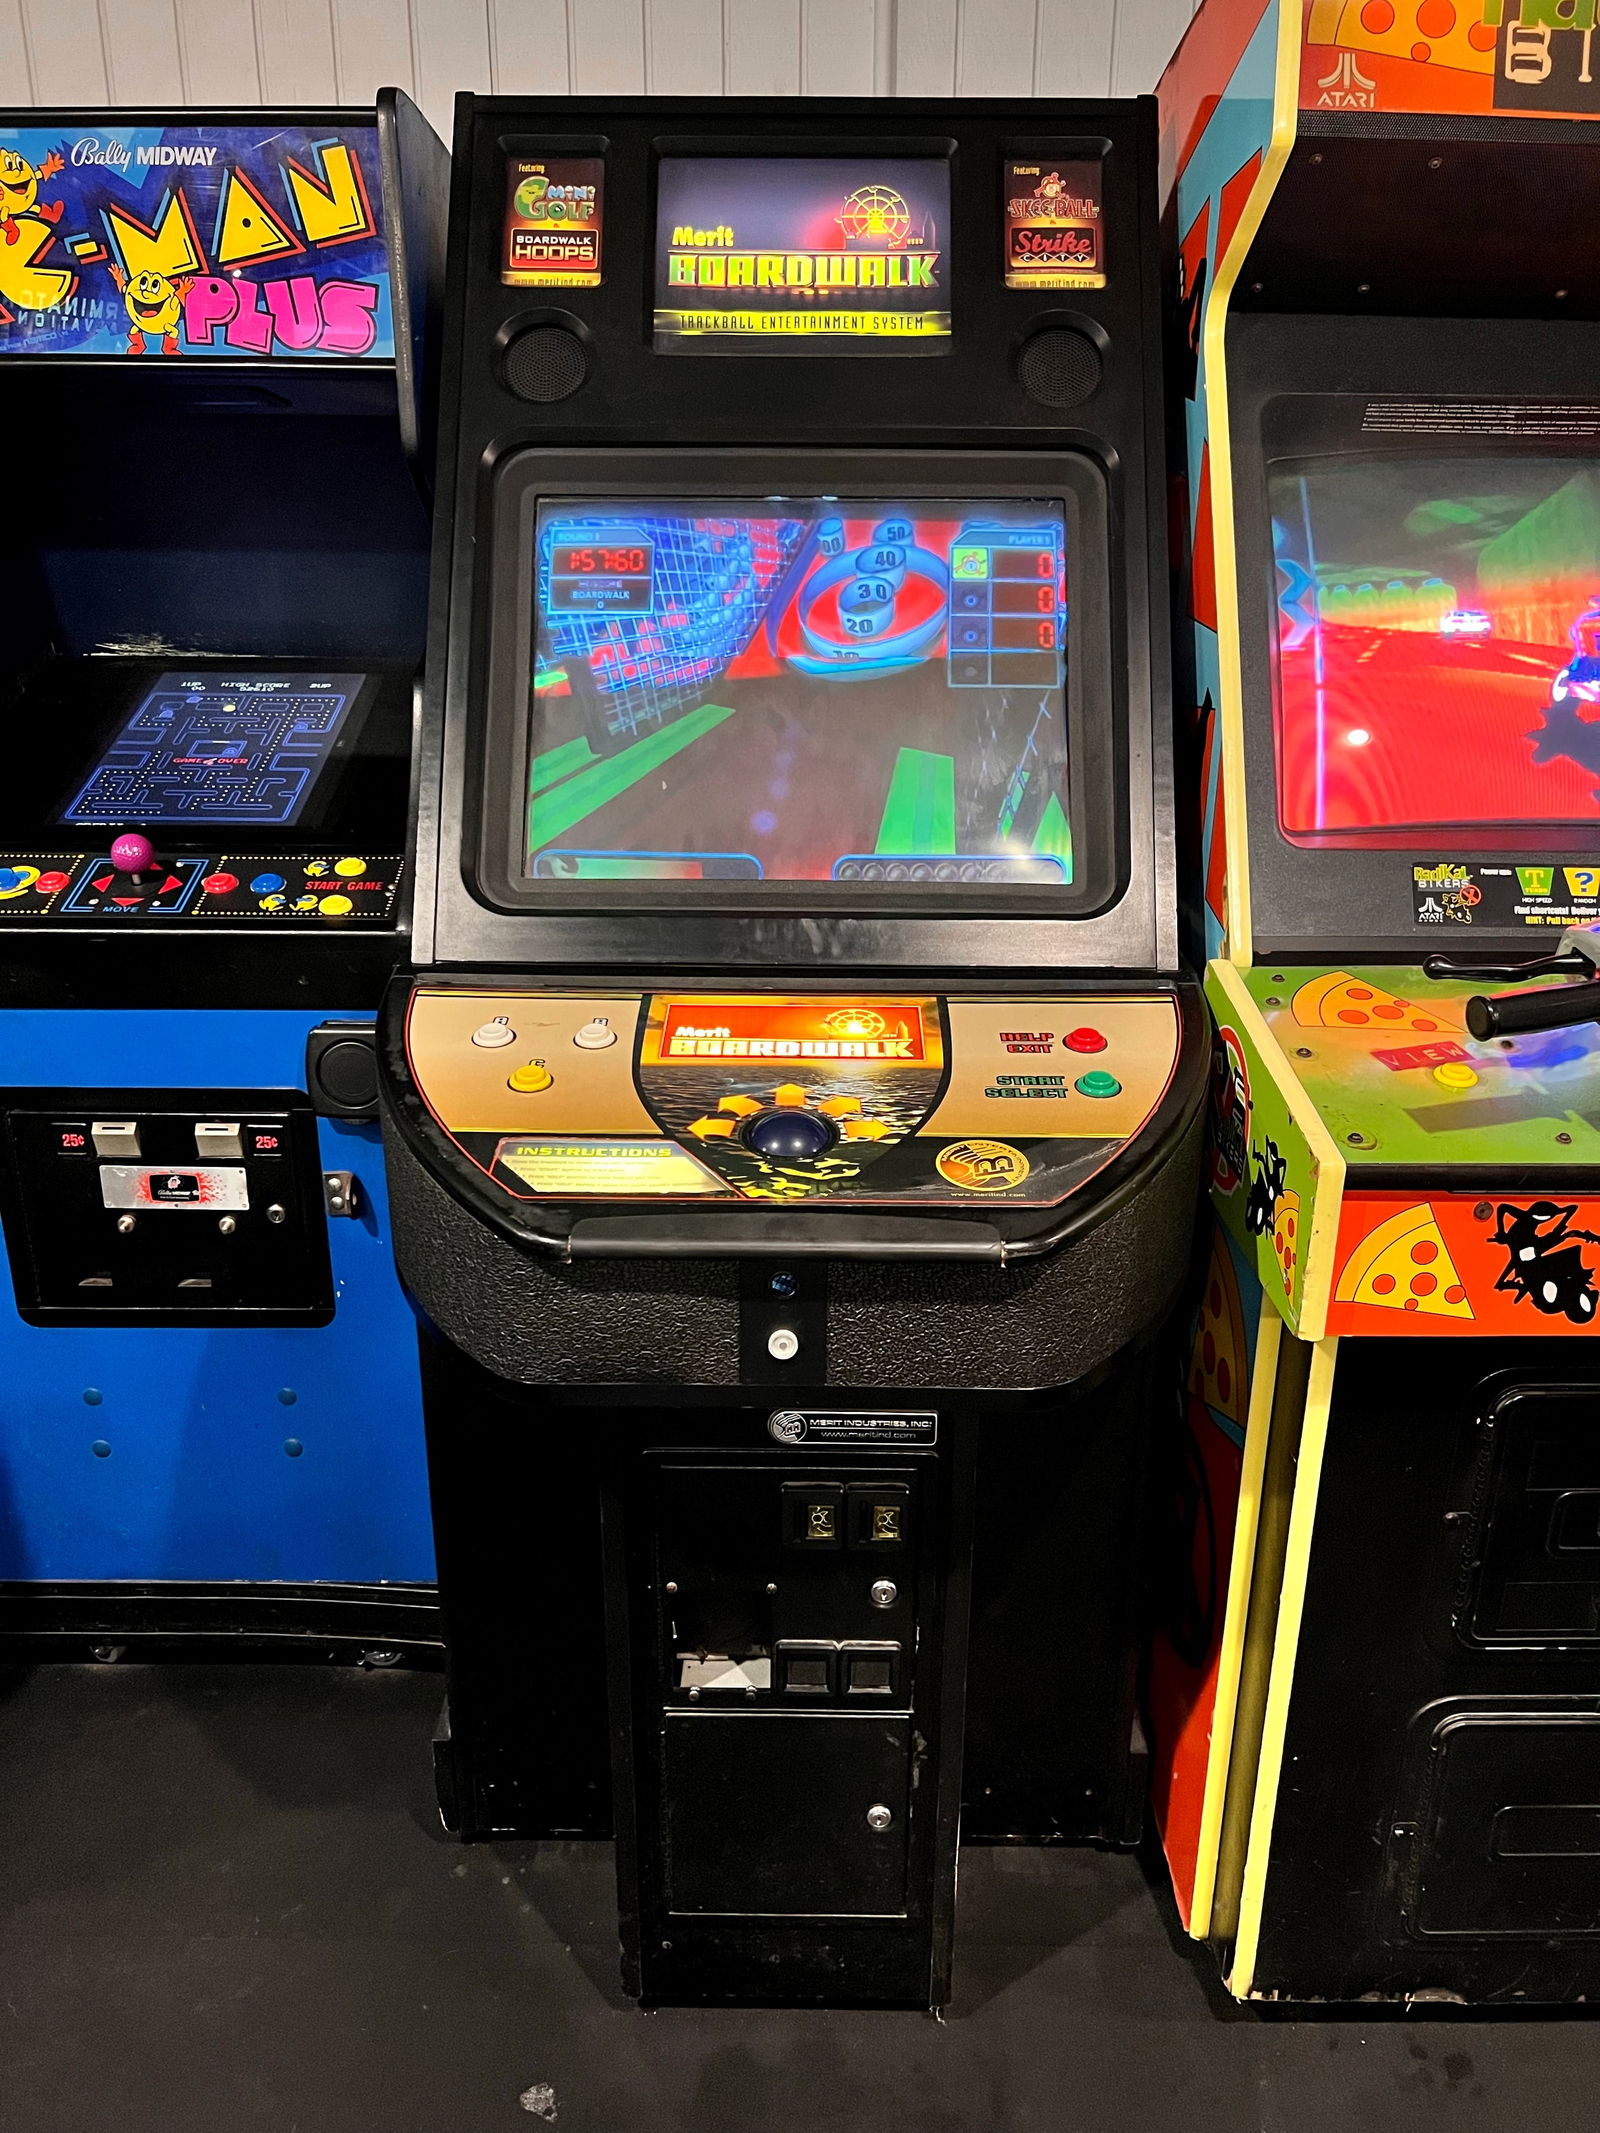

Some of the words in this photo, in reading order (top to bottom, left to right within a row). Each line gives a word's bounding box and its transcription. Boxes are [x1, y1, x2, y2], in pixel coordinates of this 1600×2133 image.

[1317, 91, 1375, 108] ATARI
[70, 137, 131, 172] Bally
[137, 147, 217, 166] MIDWAY
[519, 164, 545, 174] Featuring
[1014, 167, 1040, 176] Featuring
[514, 176, 595, 219] GOLF
[516, 235, 591, 244] BOARDWALK
[672, 226, 734, 247] Merit
[1014, 231, 1092, 252] Strike
[515, 245, 593, 261] HOOPS
[668, 254, 940, 288] BOARDWALK
[184, 275, 379, 355] PLUS
[680, 315, 754, 329] TRACKBALL
[761, 315, 866, 330] ENTERTAINMENT
[873, 316, 924, 330] SYSTEM
[887, 526, 906, 542] 50
[875, 551, 896, 567] 40
[1038, 553, 1055, 578] 0
[571, 591, 631, 600] BOARDWALK
[858, 584, 887, 600] 30
[1038, 586, 1055, 613] 0
[846, 618, 874, 634] 20
[1038, 621, 1055, 648] 0
[1418, 879, 1470, 888] BIKERS
[1525, 869, 1545, 888] T
[304, 881, 343, 891] START
[347, 881, 384, 892] GAME
[103, 906, 139, 914] MOVE
[1418, 912, 1444, 920] ATARI
[675, 1026, 731, 1038] Merit
[1000, 1033, 1055, 1042] HELP
[669, 1039, 914, 1057] BOARDWALK
[1006, 1044, 1053, 1053] EXIT
[1380, 1045, 1464, 1067] VIEW
[996, 1075, 1066, 1085] START
[985, 1087, 1069, 1098] SELECT
[62, 1134, 85, 1147] 25¢
[255, 1135, 278, 1149] 25¢
[516, 1146, 673, 1157] INSTRUCTIONS
[844, 1420, 909, 1428] INDUSTRIES,
